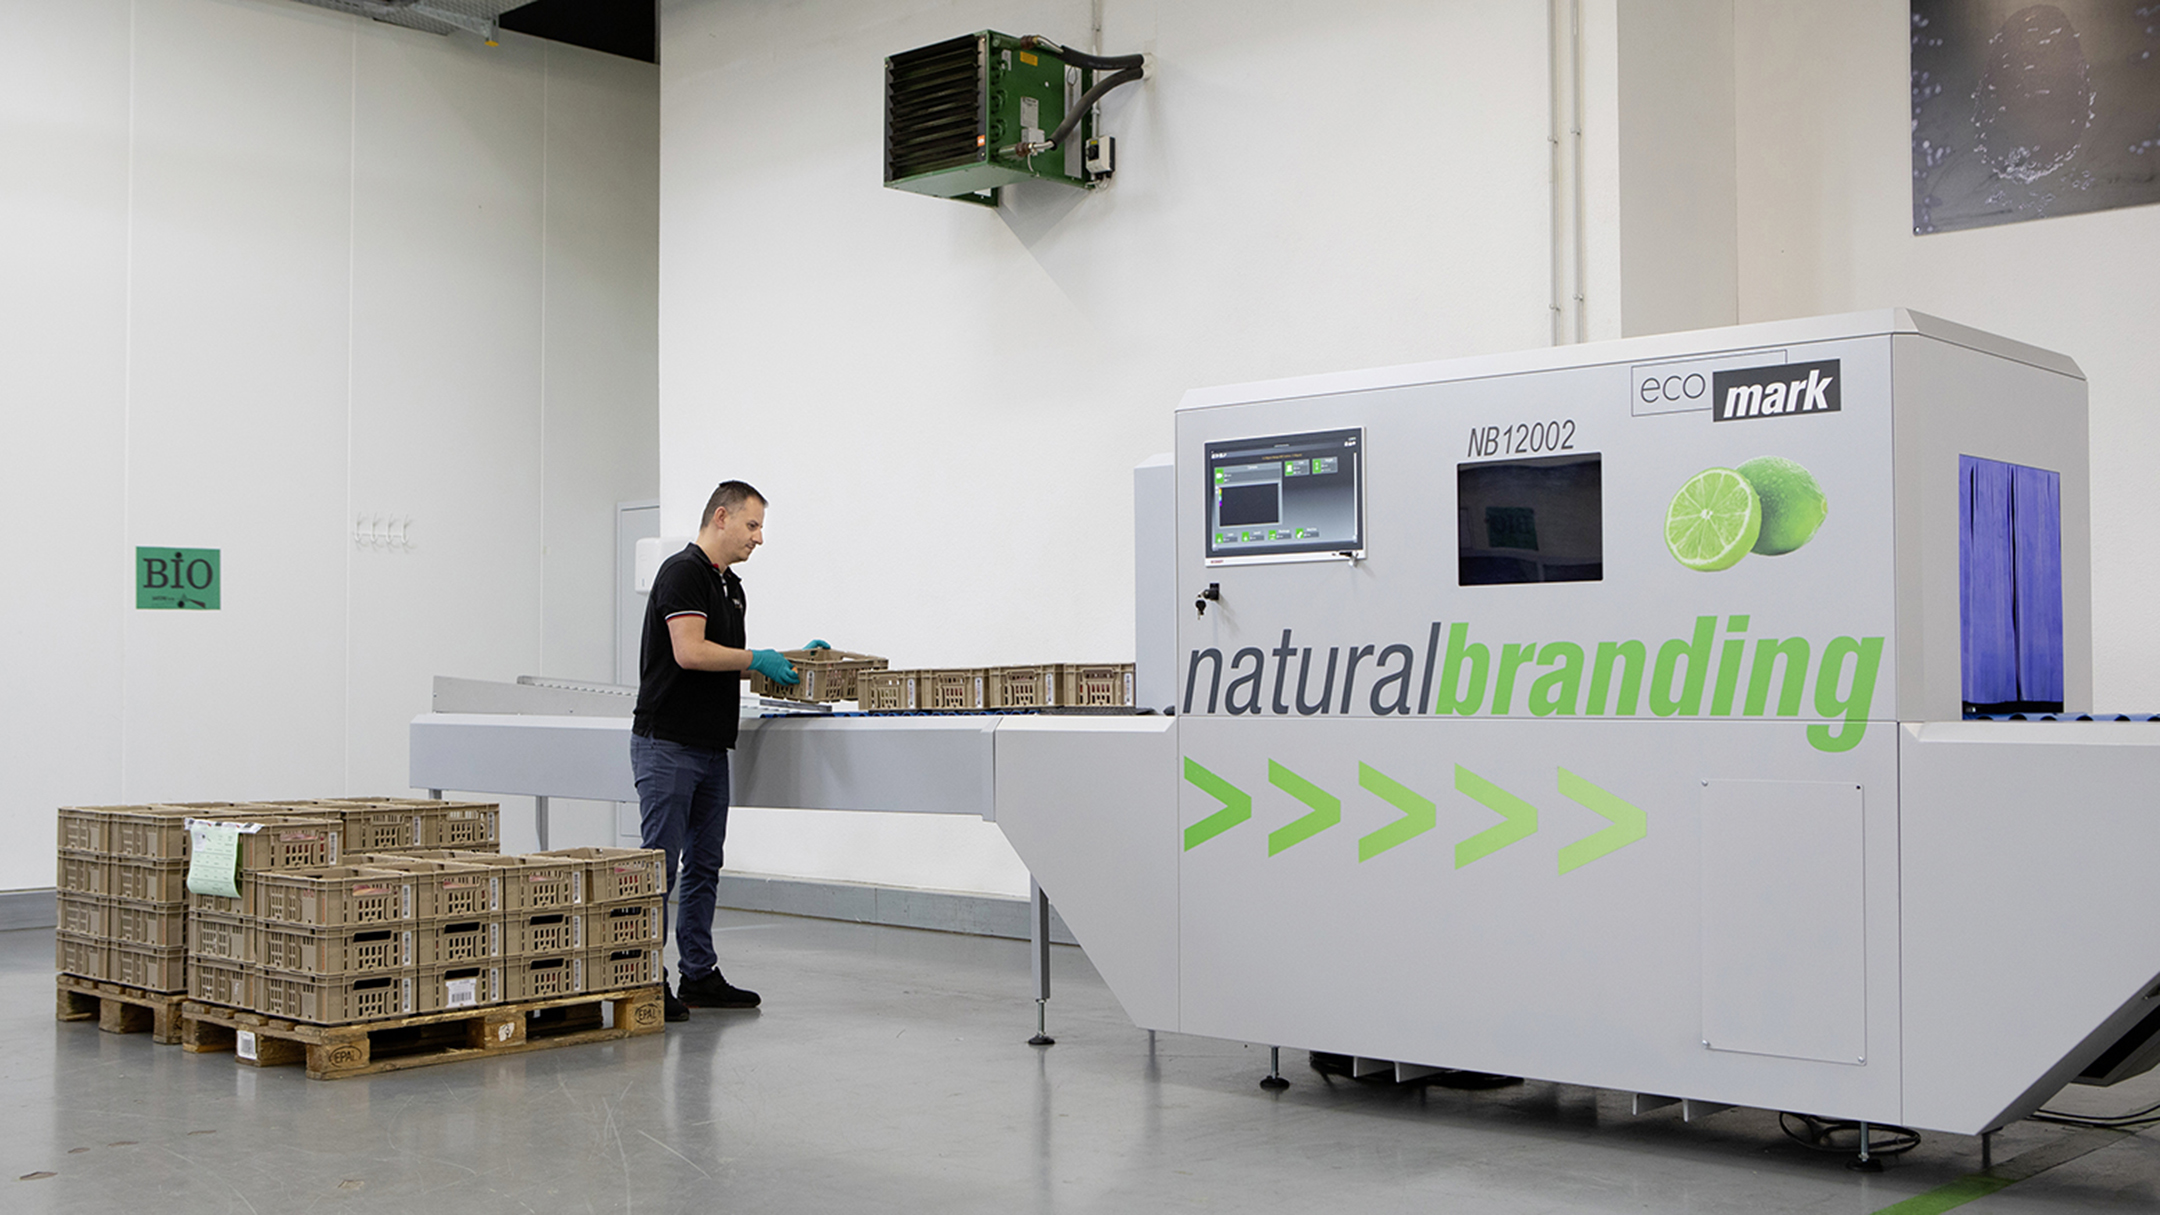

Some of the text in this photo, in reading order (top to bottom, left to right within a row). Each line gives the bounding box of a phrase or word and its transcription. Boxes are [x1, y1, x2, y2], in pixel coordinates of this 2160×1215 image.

[1640, 369, 1834, 418] eco mark
[1467, 419, 1576, 458] NB12002
